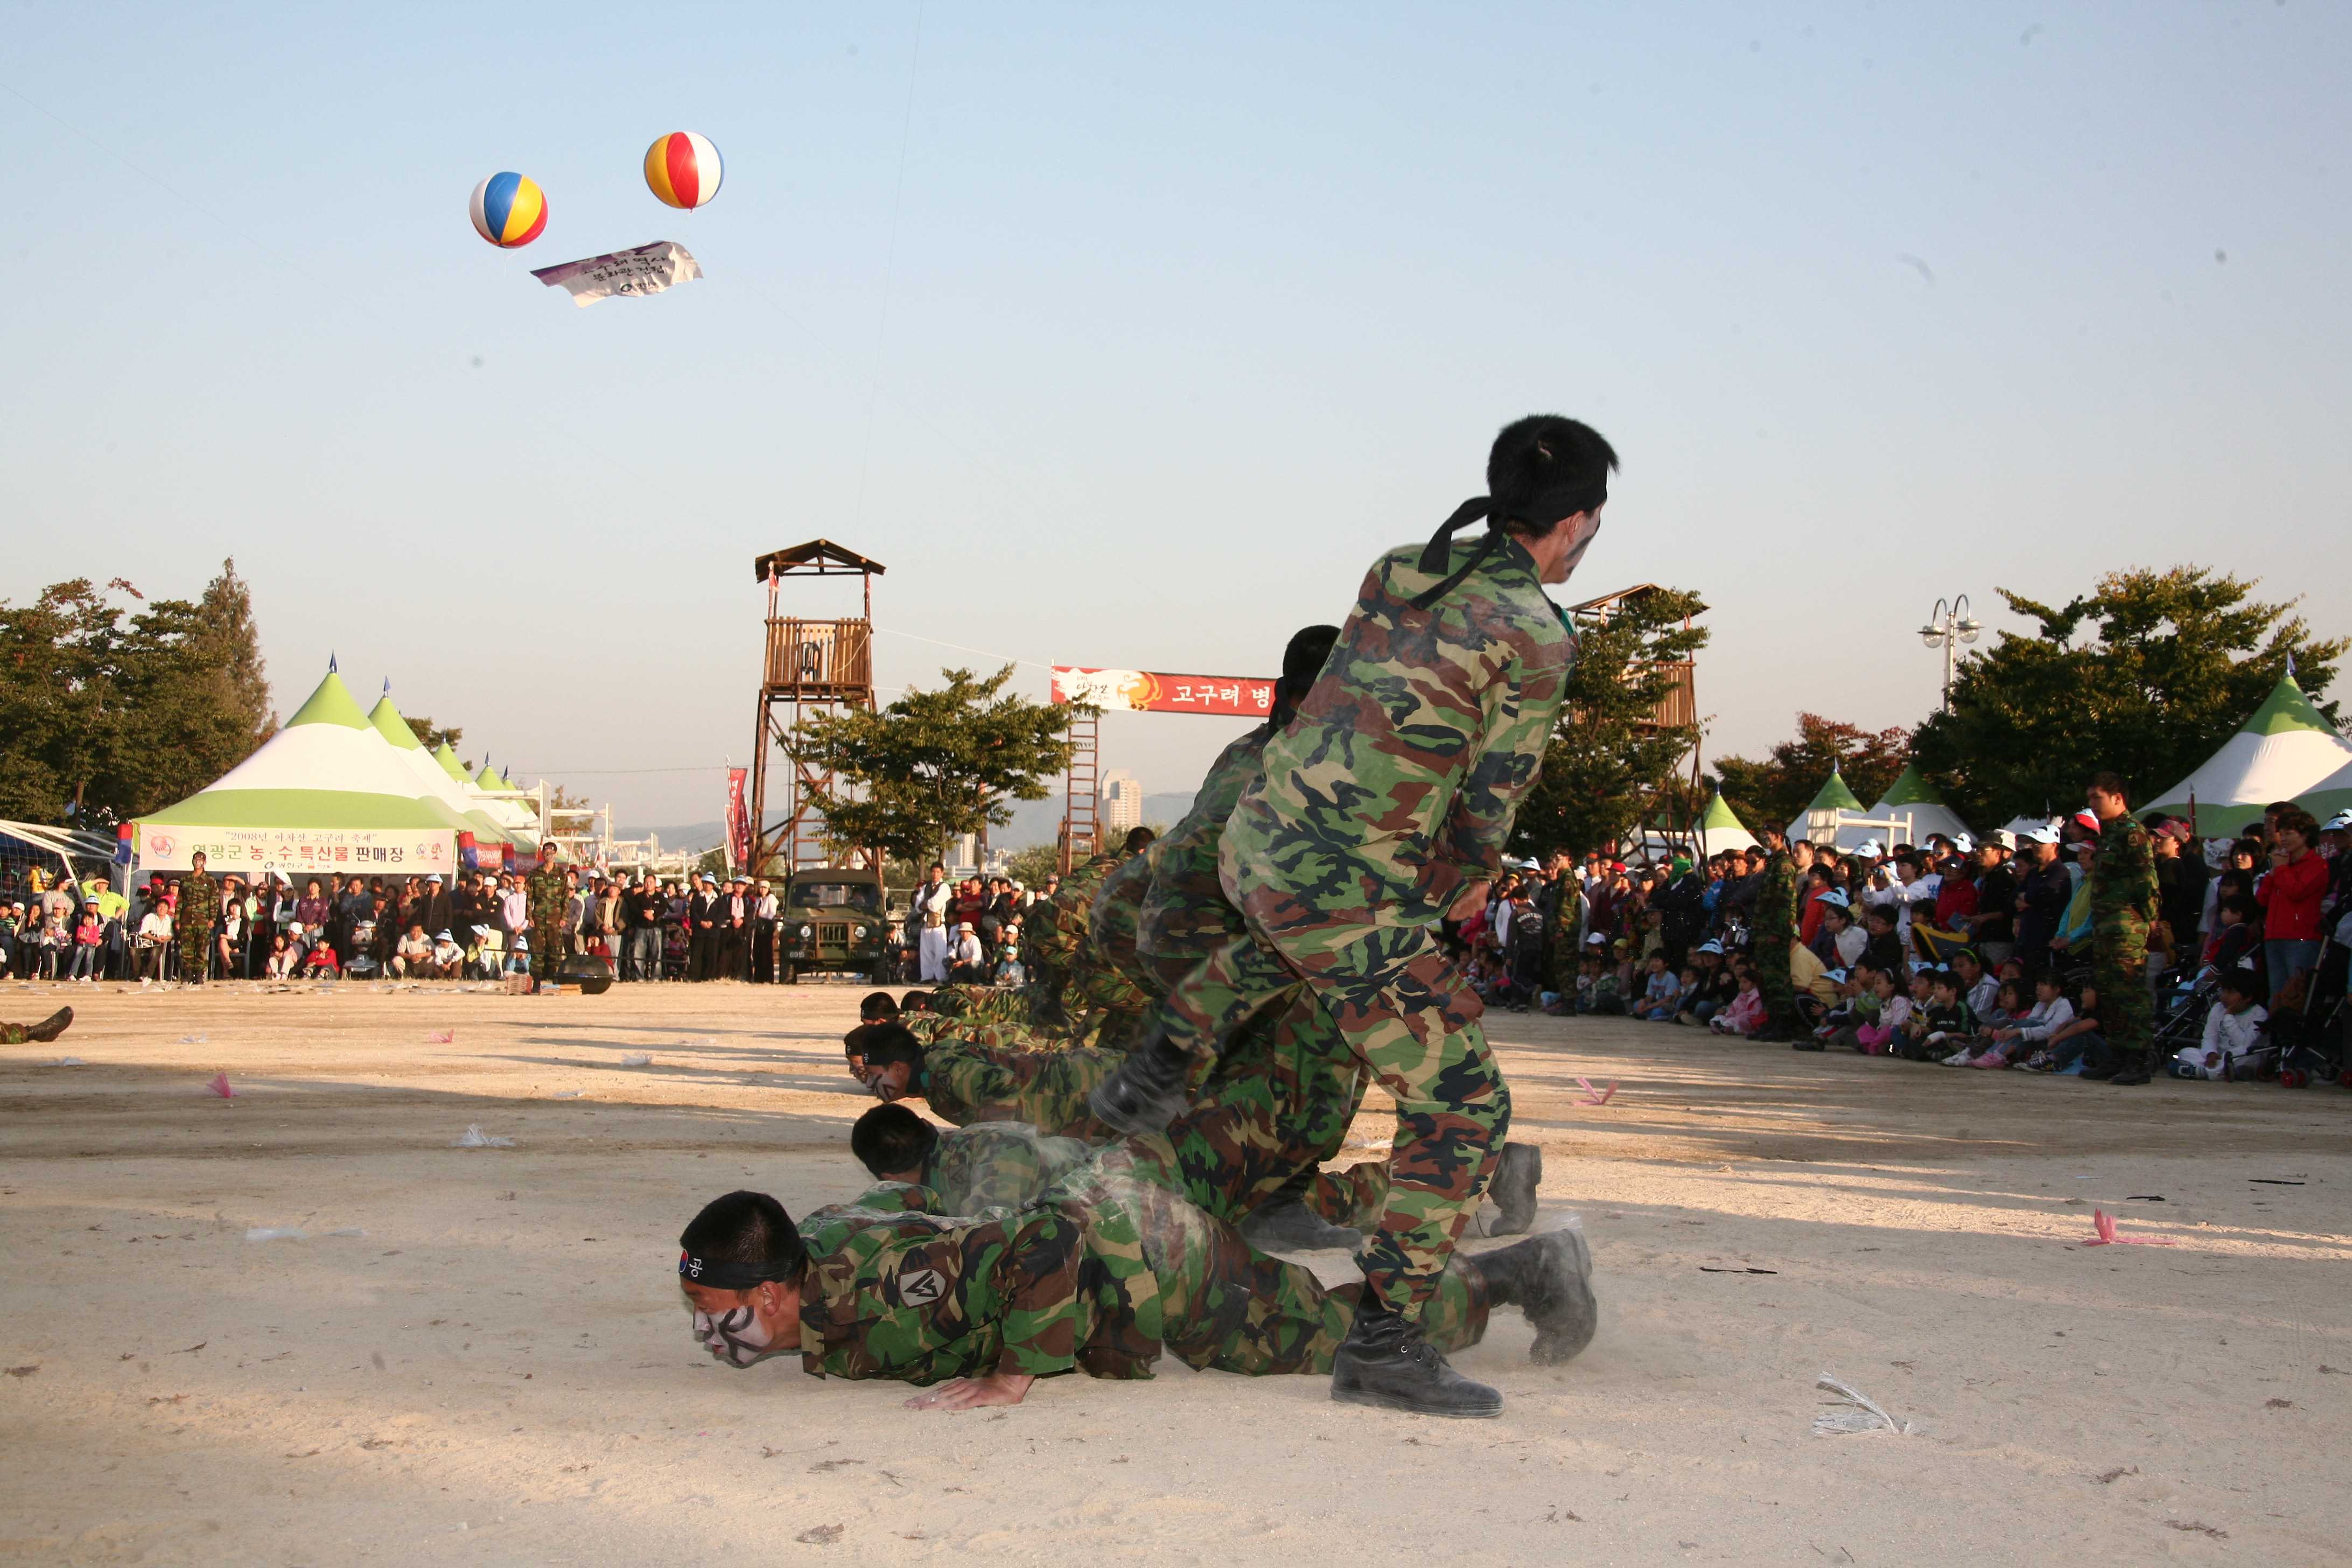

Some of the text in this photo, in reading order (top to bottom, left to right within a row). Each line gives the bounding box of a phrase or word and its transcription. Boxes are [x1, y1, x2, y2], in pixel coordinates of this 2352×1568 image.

[1172, 685, 1270, 708] 고구려 병
[275, 832, 306, 843] 아차산
[300, 846, 348, 862] 특산물
[356, 847, 404, 862] 판매장
[689, 1257, 703, 1277] 공
